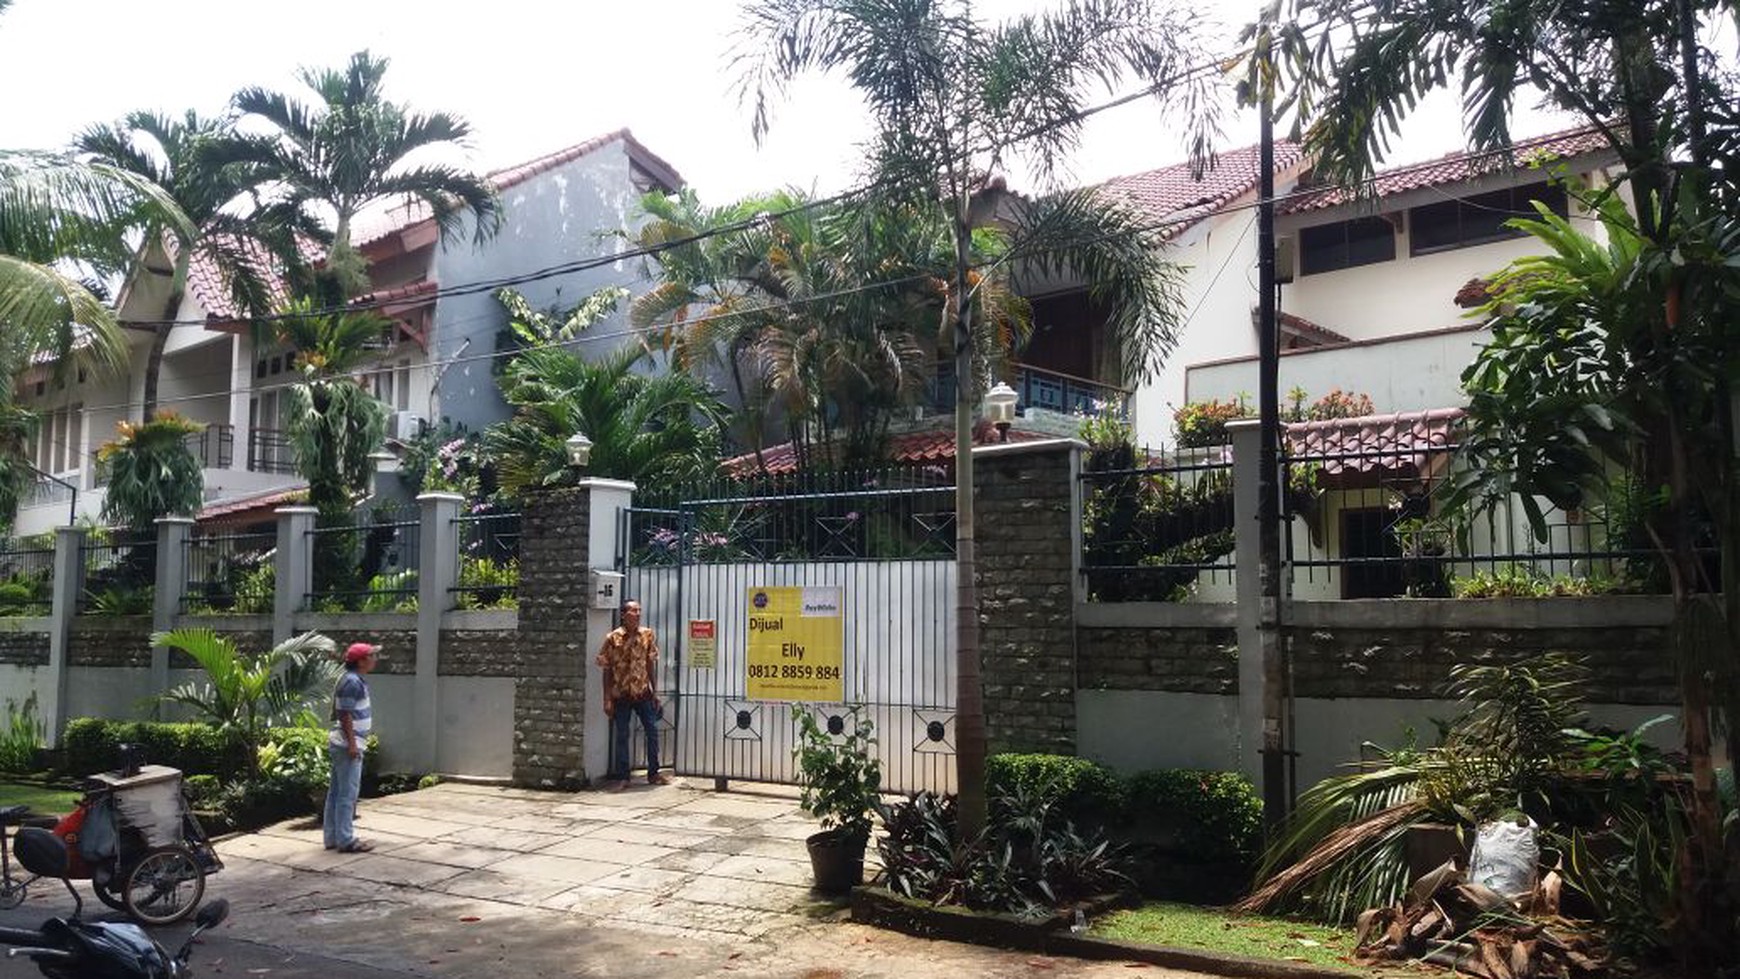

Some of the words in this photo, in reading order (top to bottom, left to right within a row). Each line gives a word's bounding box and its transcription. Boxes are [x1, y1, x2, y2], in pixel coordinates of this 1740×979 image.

[749, 617, 784, 633] Dijual
[782, 641, 805, 661] Elly
[748, 664, 779, 679] 0812
[781, 665, 813, 680] 8859
[815, 666, 840, 680] 884
